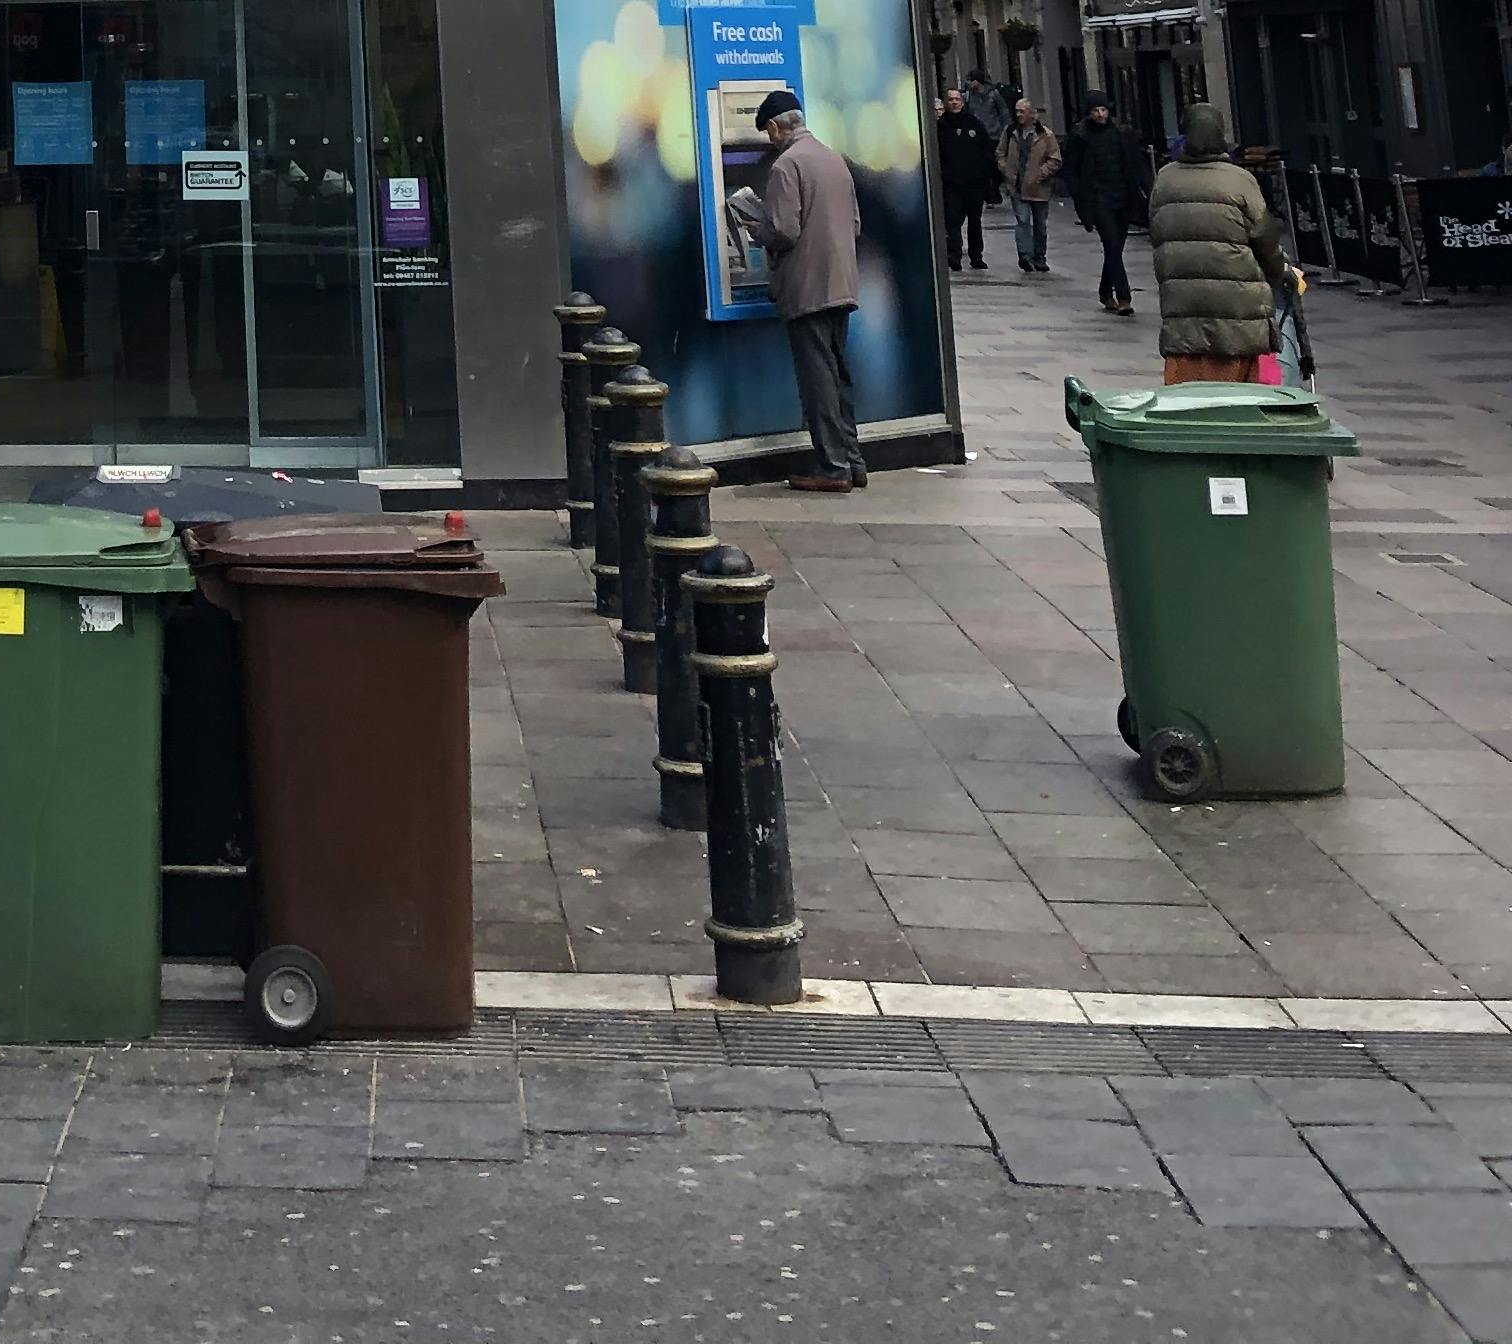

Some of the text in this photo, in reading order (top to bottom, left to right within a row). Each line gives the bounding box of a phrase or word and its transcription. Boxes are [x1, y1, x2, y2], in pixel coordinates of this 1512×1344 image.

[711, 21, 783, 42] Free cash
[714, 48, 785, 65] withdrawals
[17, 86, 68, 97] Opening hours
[189, 177, 235, 185] GUARANTEE
[1442, 219, 1501, 237] Head
[1442, 233, 1512, 248] of Stea
